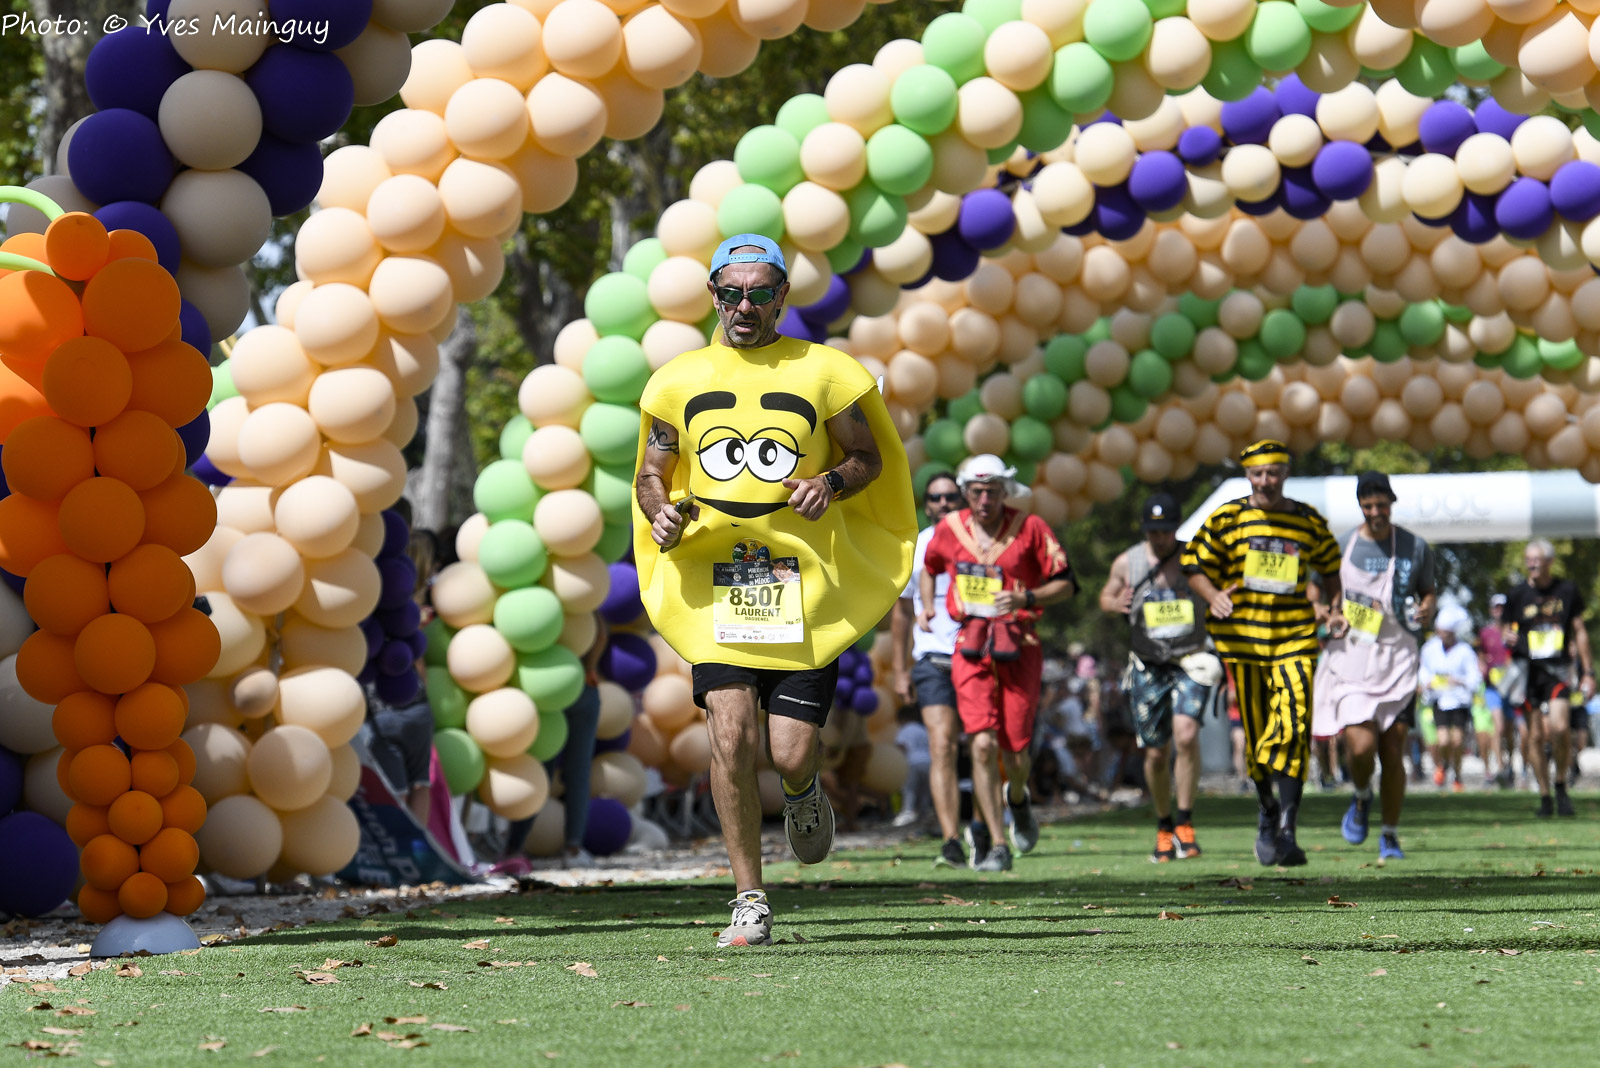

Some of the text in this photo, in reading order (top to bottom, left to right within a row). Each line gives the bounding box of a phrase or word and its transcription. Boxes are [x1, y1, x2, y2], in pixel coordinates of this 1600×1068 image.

[1260, 551, 1286, 567] 337
[729, 584, 785, 607] 8507
[735, 607, 781, 618] LAURENT
